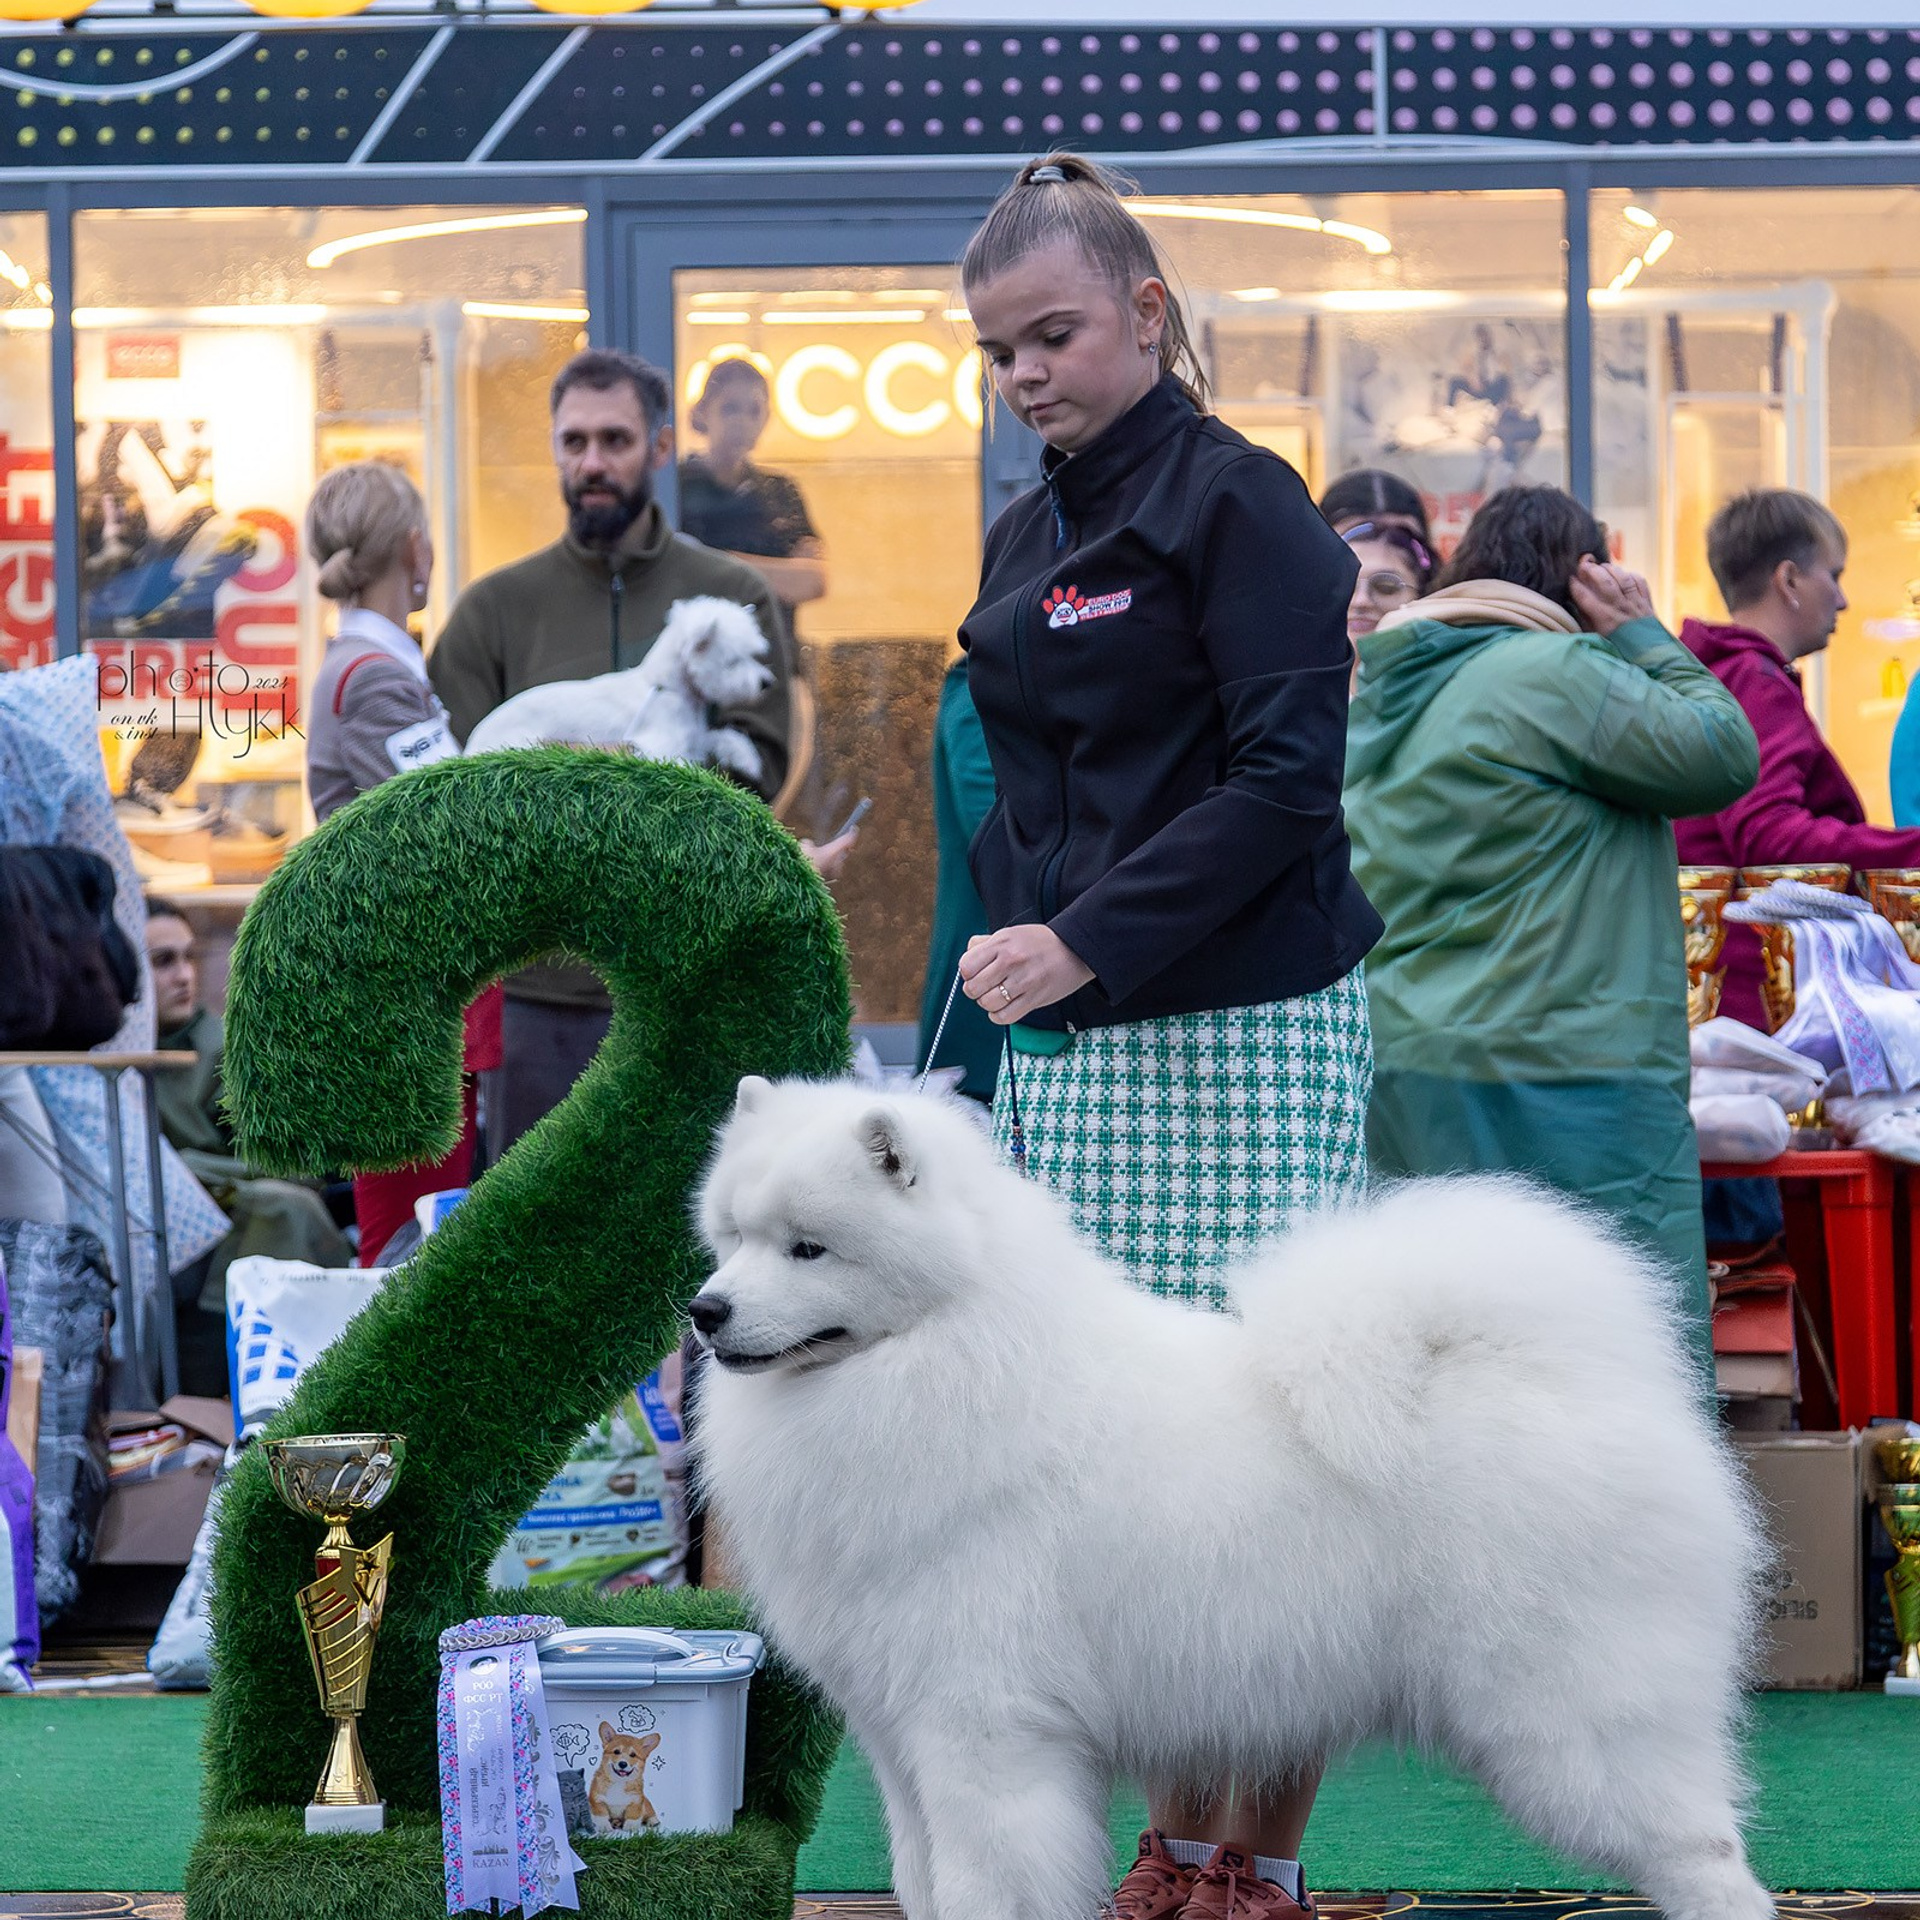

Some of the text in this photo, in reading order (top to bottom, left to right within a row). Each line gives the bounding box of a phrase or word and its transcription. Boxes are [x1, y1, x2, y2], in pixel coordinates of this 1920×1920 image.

[1088, 590, 1131, 605] EURO DOG
[463, 1693, 504, 1703] ФСС РТ
[472, 1858, 510, 1869] KAZAN
